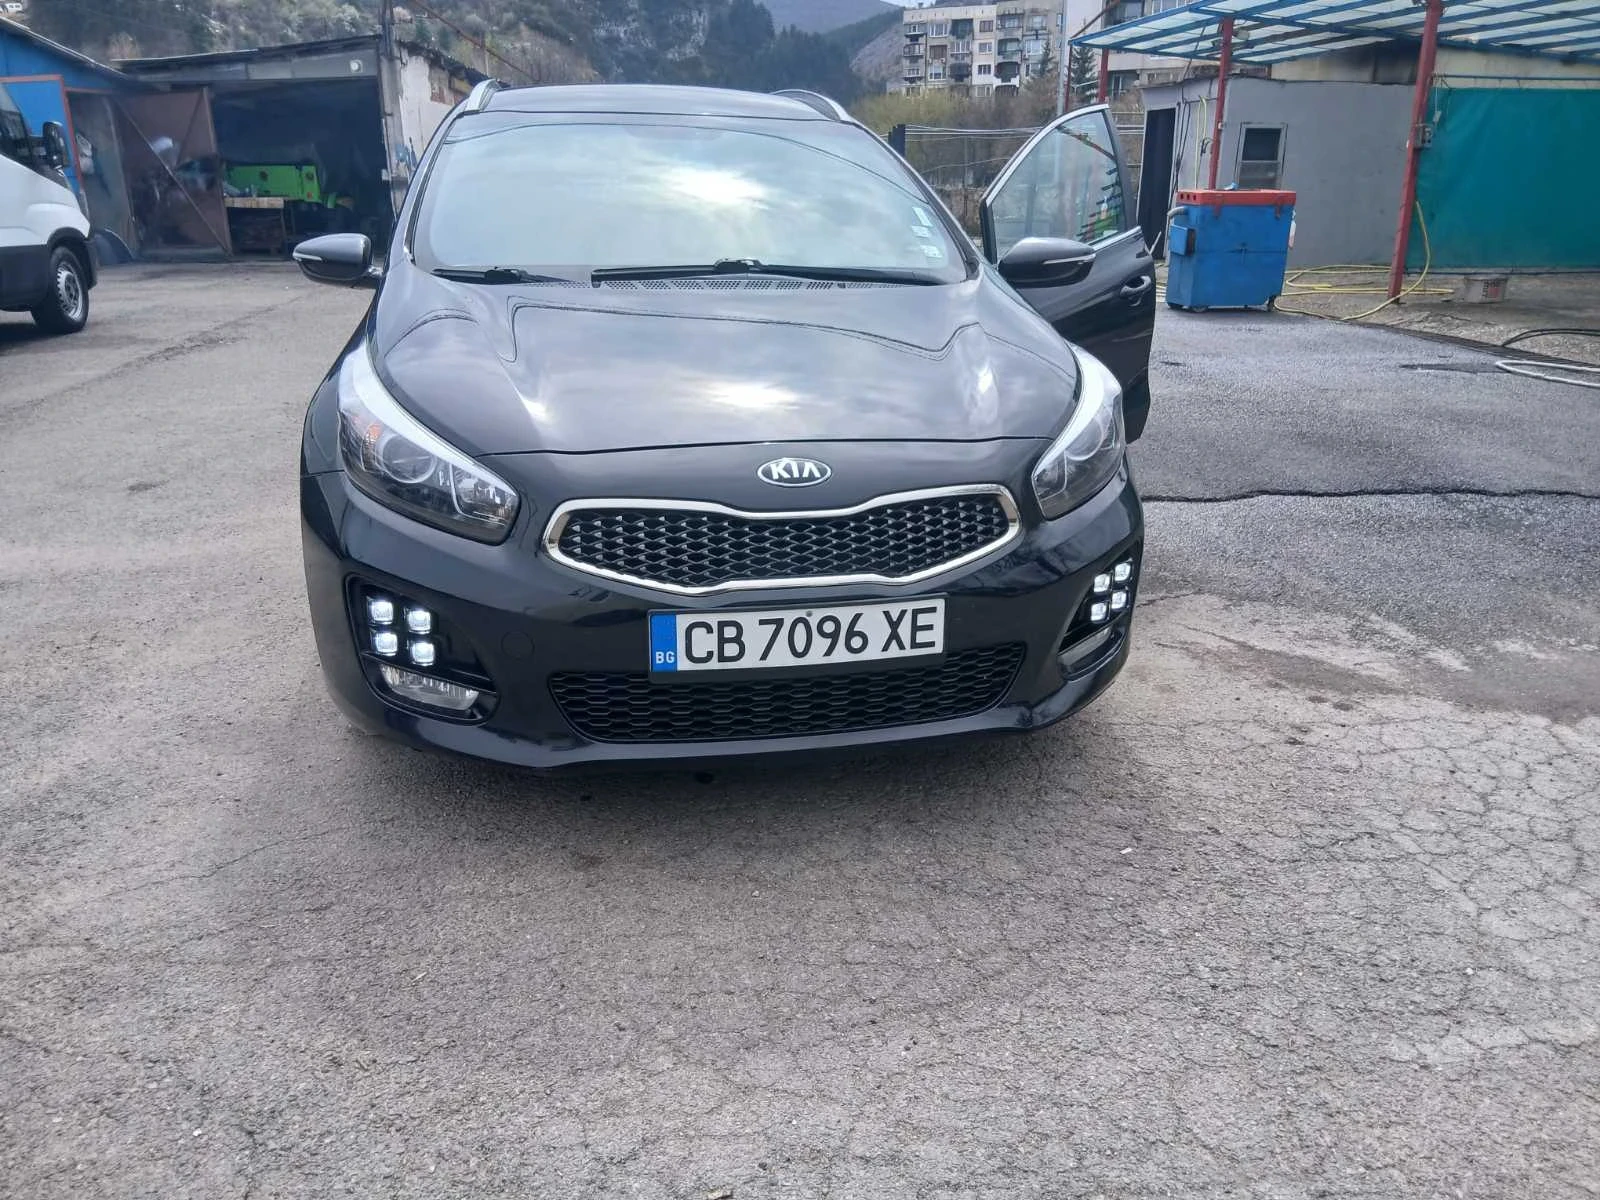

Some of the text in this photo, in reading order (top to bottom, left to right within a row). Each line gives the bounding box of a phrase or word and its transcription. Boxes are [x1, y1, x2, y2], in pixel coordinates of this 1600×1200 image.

[769, 461, 821, 480] KIA
[684, 606, 938, 664] CB 7096 XE
[655, 651, 676, 664] BG
